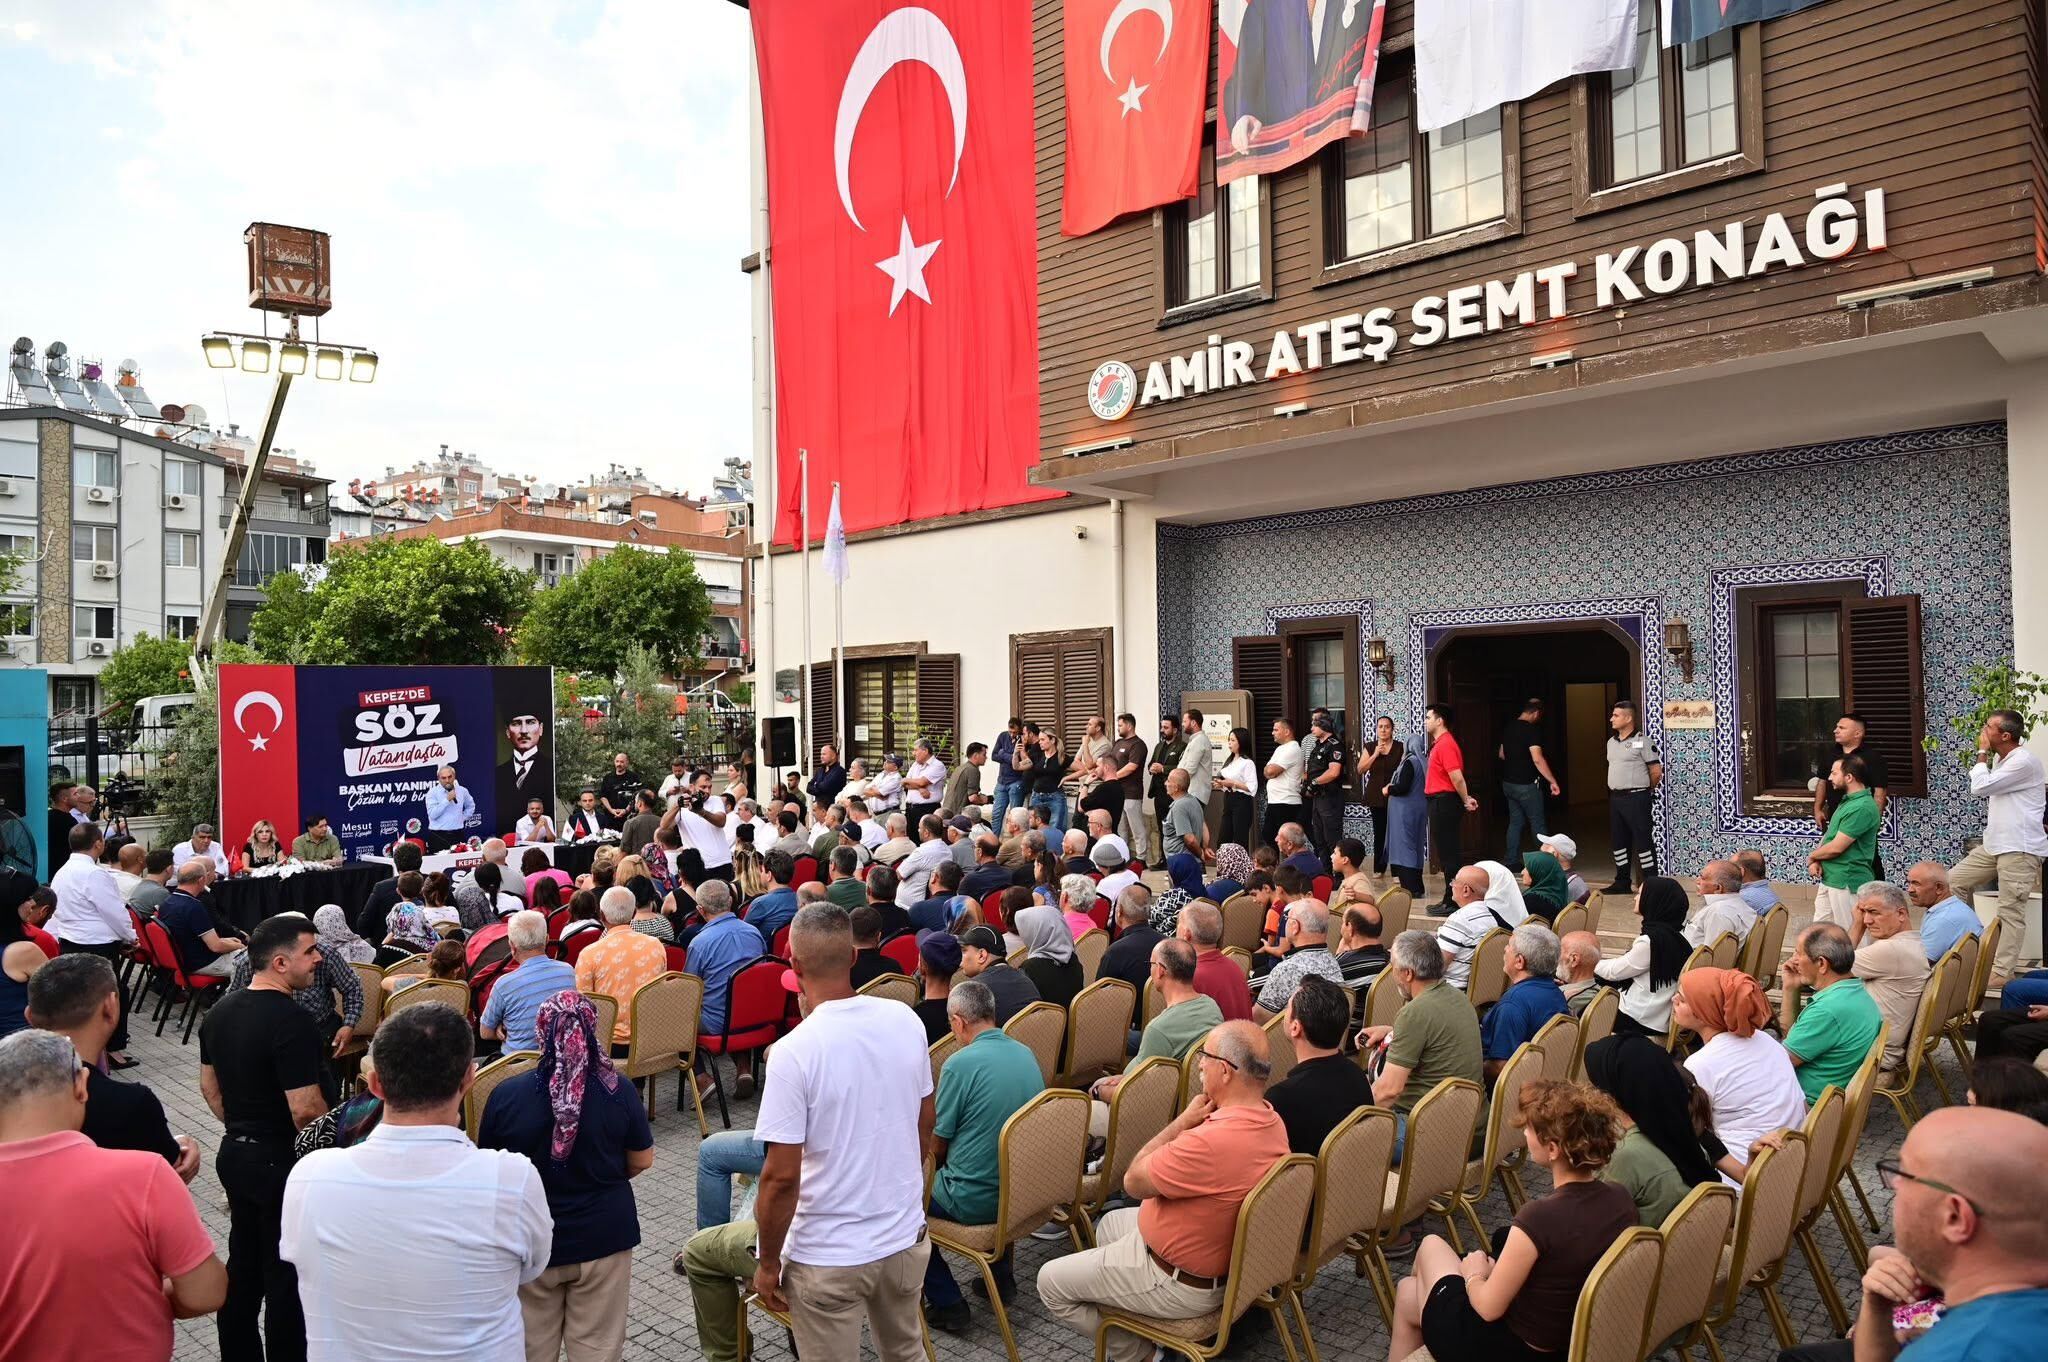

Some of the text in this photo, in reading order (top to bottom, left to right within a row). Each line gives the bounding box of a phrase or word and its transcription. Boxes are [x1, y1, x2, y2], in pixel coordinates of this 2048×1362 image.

[1140, 182, 1888, 406] AMİR ATEŞ SEMT KONAĞI
[1093, 366, 1127, 387] KEPEZ
[365, 688, 425, 704] KEPEZ'DE
[355, 704, 443, 742] SÖZ
[358, 741, 446, 772] Vatandaşta
[339, 783, 392, 796] BAŞKAN
[347, 792, 385, 811] Çözüm
[389, 792, 407, 805] hep
[341, 822, 372, 832] Mesut
[458, 858, 483, 867] KEPEZ'
